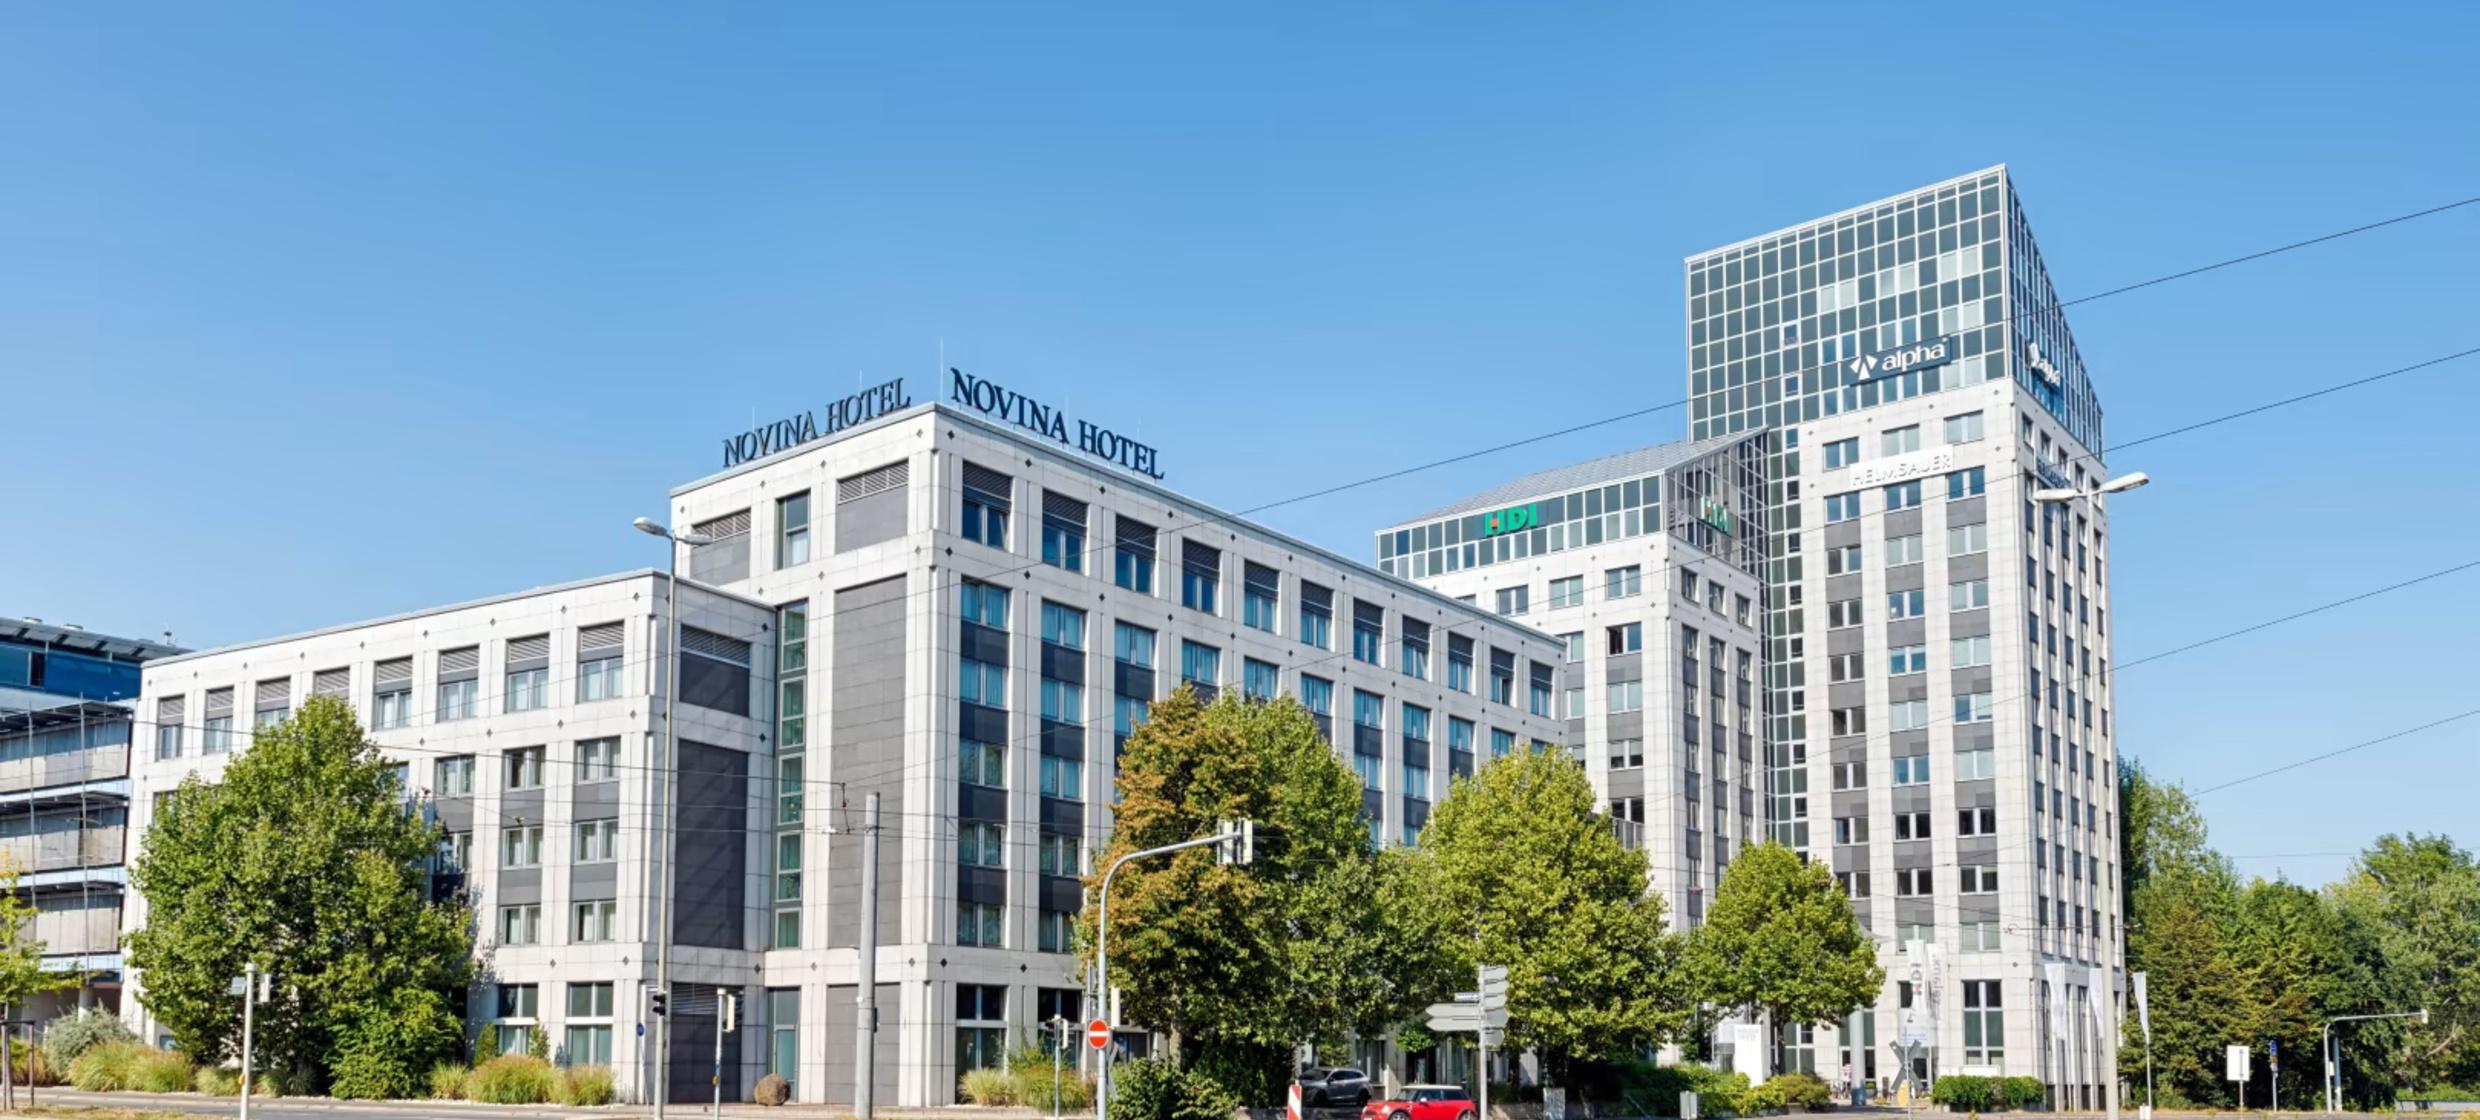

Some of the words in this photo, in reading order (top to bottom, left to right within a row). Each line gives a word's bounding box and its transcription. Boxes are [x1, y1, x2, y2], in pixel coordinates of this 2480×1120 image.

[1882, 343, 1945, 372] alpha
[722, 410, 818, 467] NOVINA
[825, 377, 911, 433] HOTEL
[951, 367, 1070, 445] NOVINA
[1078, 419, 1165, 480] HOTEL
[1484, 502, 1537, 537] HDI
